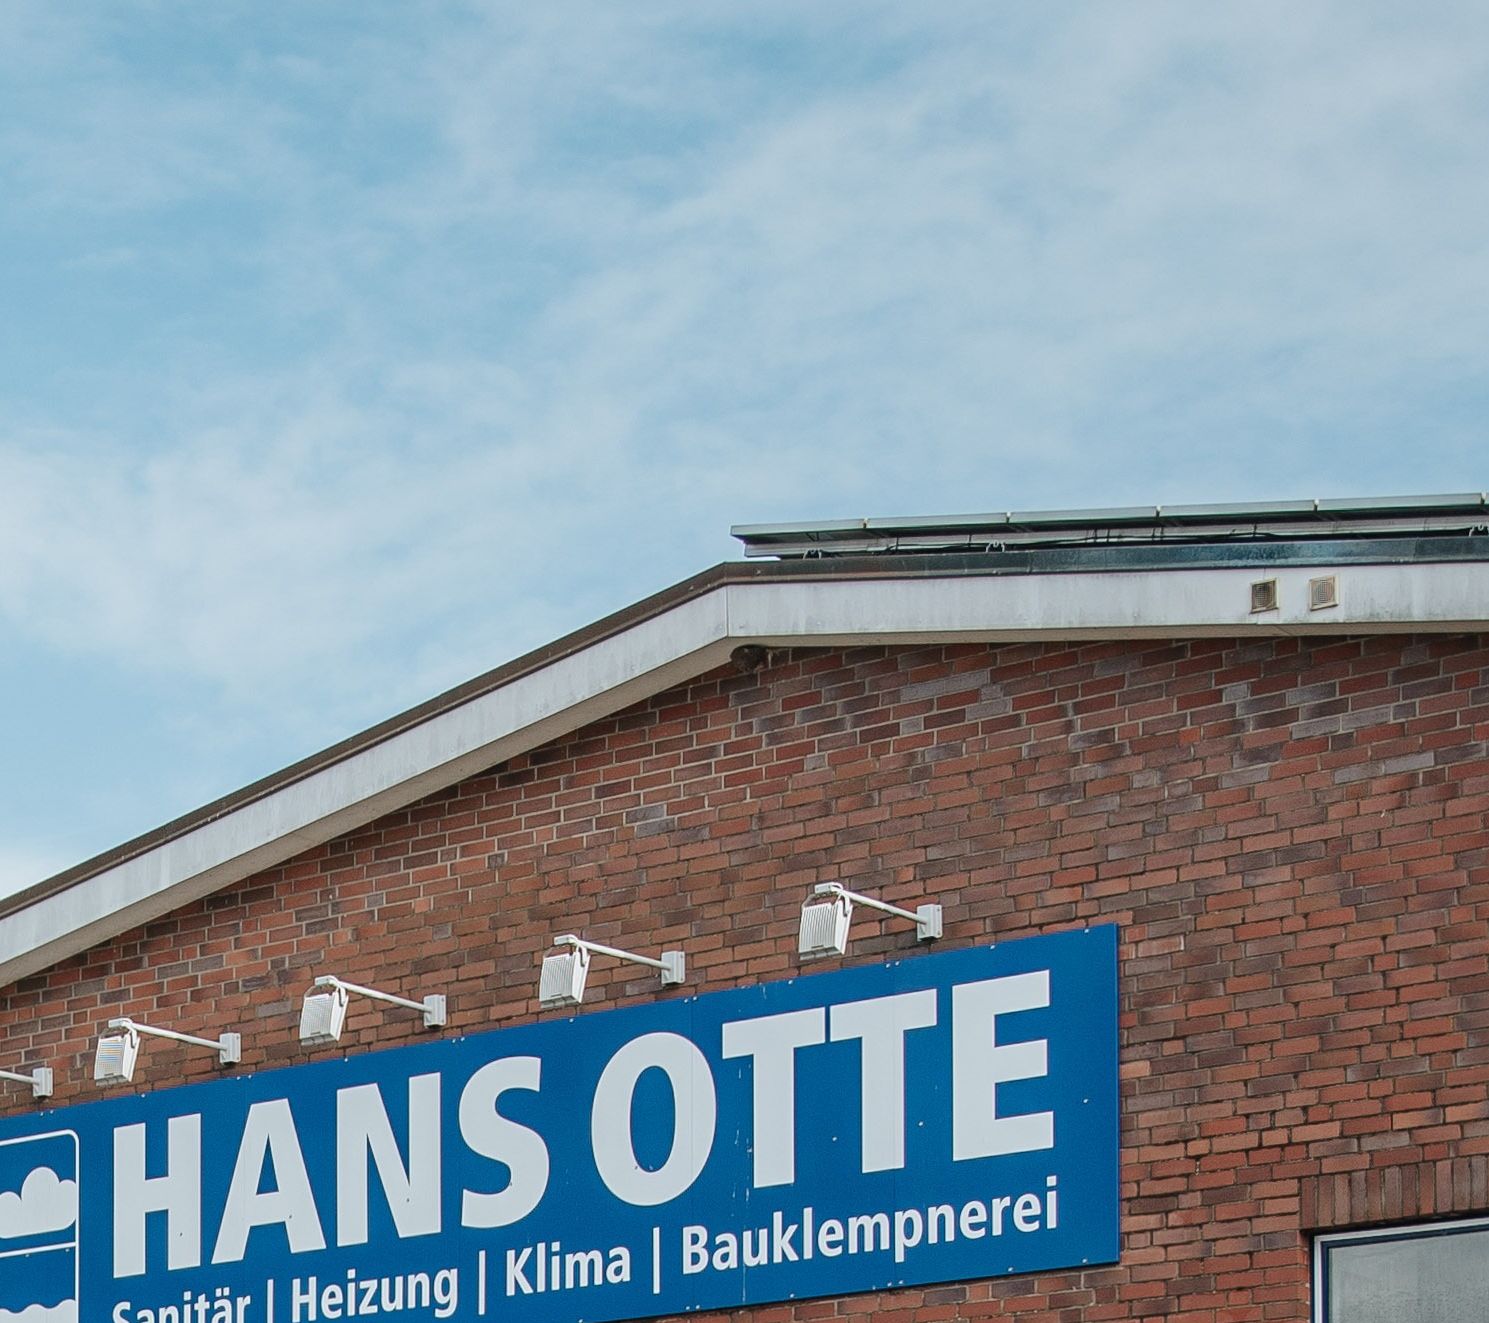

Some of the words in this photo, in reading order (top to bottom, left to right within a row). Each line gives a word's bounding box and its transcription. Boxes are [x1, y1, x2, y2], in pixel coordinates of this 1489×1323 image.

[113, 1056, 551, 1280] HANS
[590, 969, 1055, 1208] OTTE
[292, 1269, 457, 1323] Heizung
[507, 1242, 630, 1296] Klima
[683, 1175, 1058, 1275] Bauklempnerei
